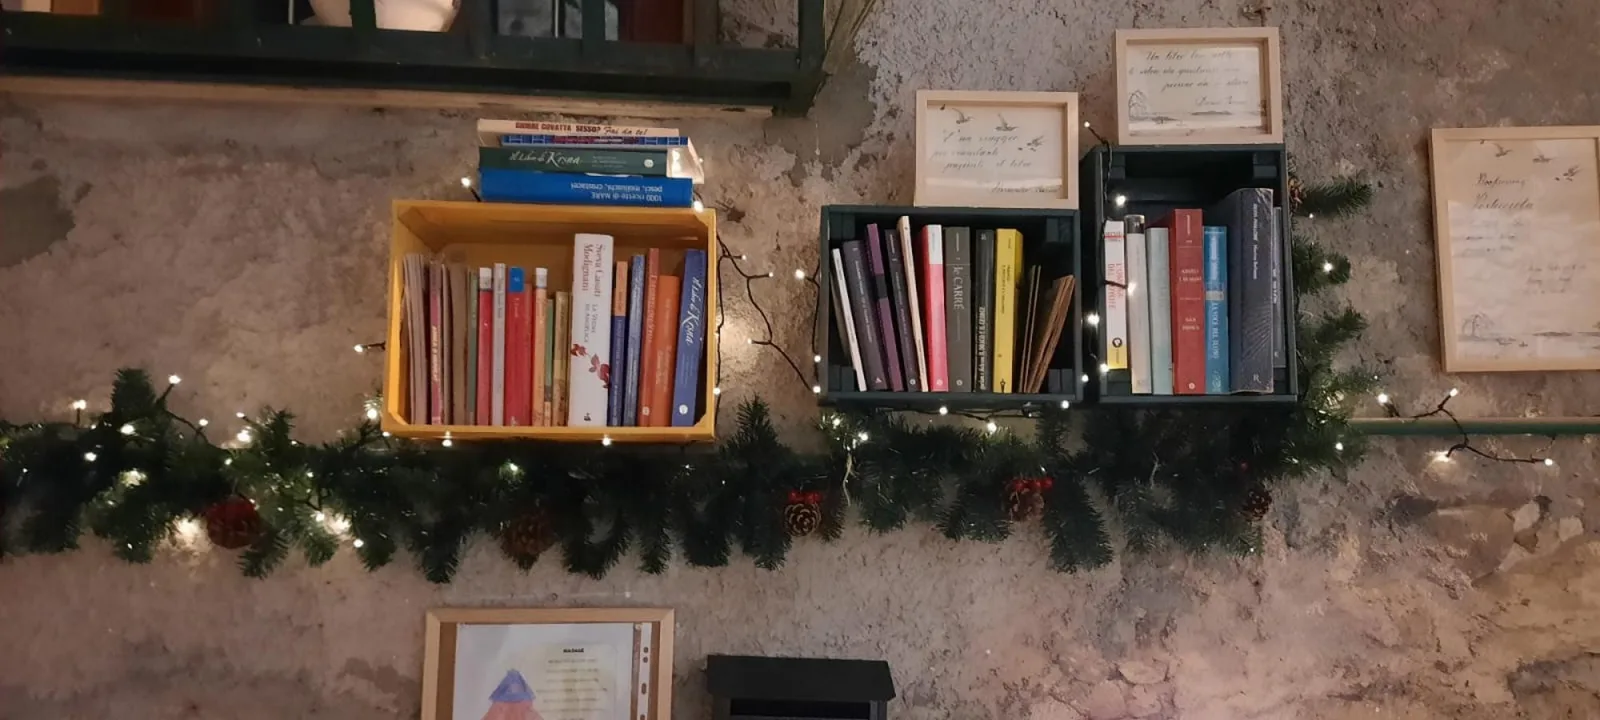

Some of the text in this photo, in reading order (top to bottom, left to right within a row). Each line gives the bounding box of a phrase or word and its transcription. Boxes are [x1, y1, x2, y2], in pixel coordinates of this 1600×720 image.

[591, 191, 611, 199] MARE
[619, 192, 645, 201] ricette
[646, 193, 663, 202] 1000
[594, 243, 605, 268] Sveva
[581, 243, 593, 292] Modignani
